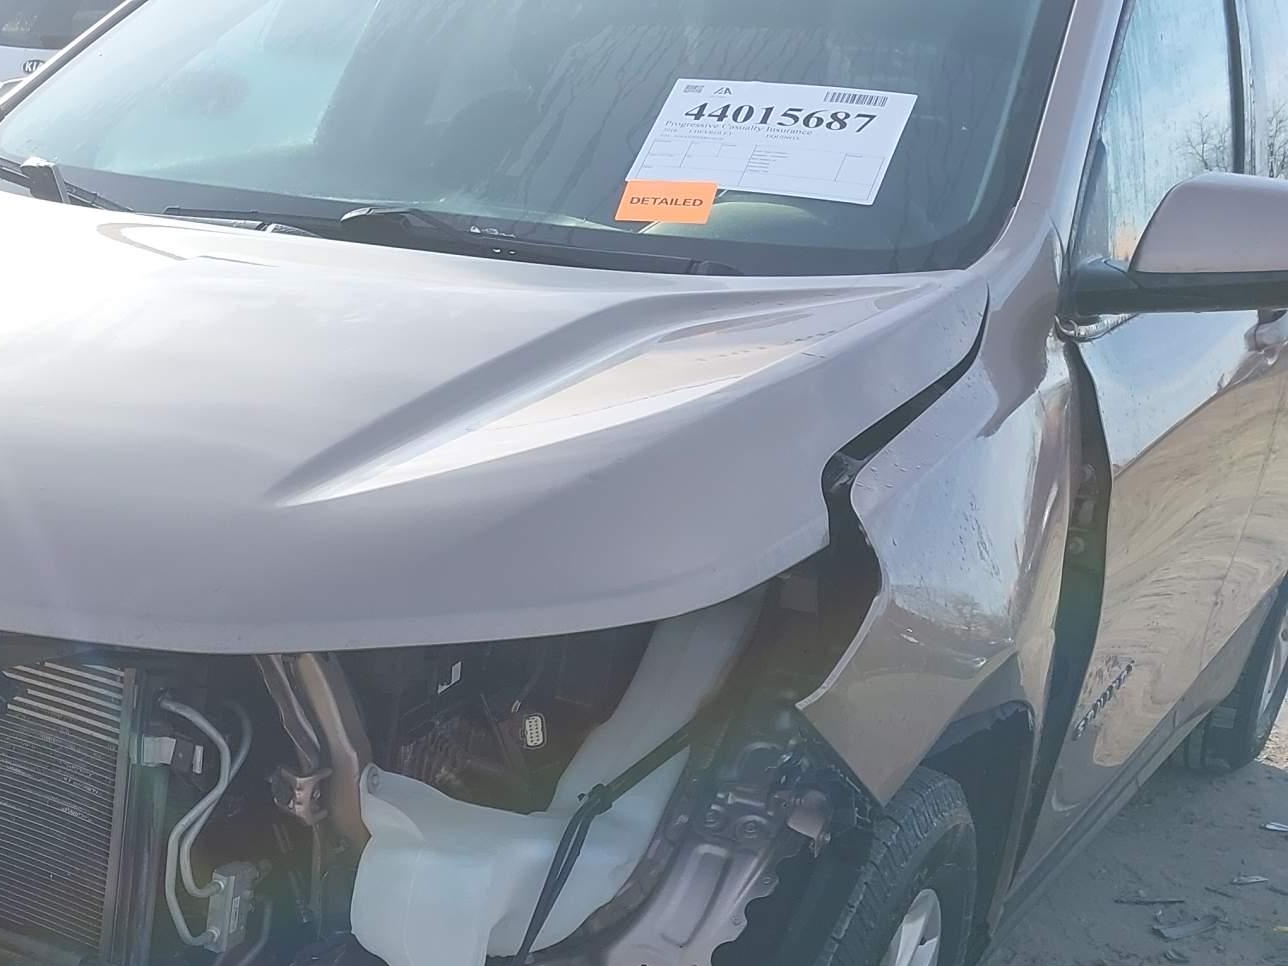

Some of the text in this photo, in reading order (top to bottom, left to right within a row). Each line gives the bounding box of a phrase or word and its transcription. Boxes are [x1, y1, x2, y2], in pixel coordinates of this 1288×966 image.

[684, 102, 877, 133] 44015687
[665, 120, 813, 135] Progressive Casualty Insurance
[630, 196, 704, 208] DETAILED
